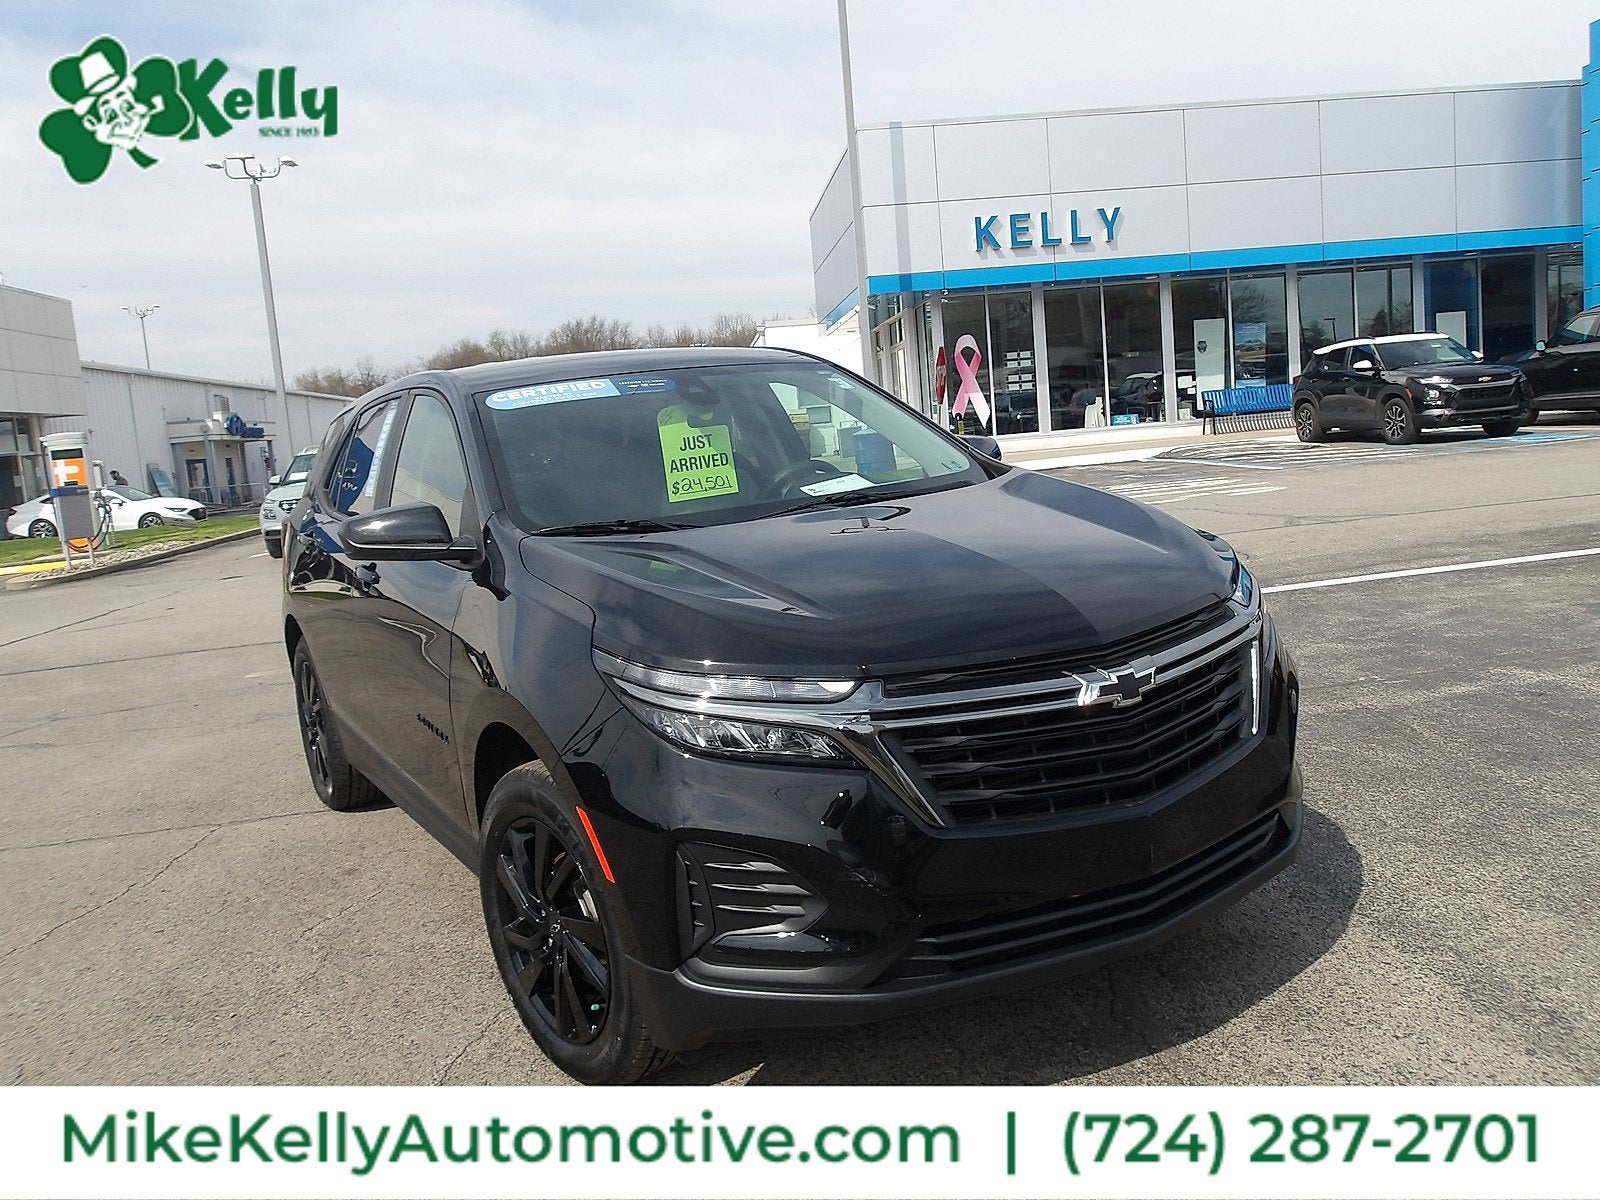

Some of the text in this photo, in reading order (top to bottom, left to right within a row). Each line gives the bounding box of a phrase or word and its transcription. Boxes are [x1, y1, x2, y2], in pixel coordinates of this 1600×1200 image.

[974, 206, 1121, 252] KELLY
[491, 379, 606, 402] CERTIFIED
[679, 433, 713, 452] JUST
[669, 452, 729, 474] ARRIVED
